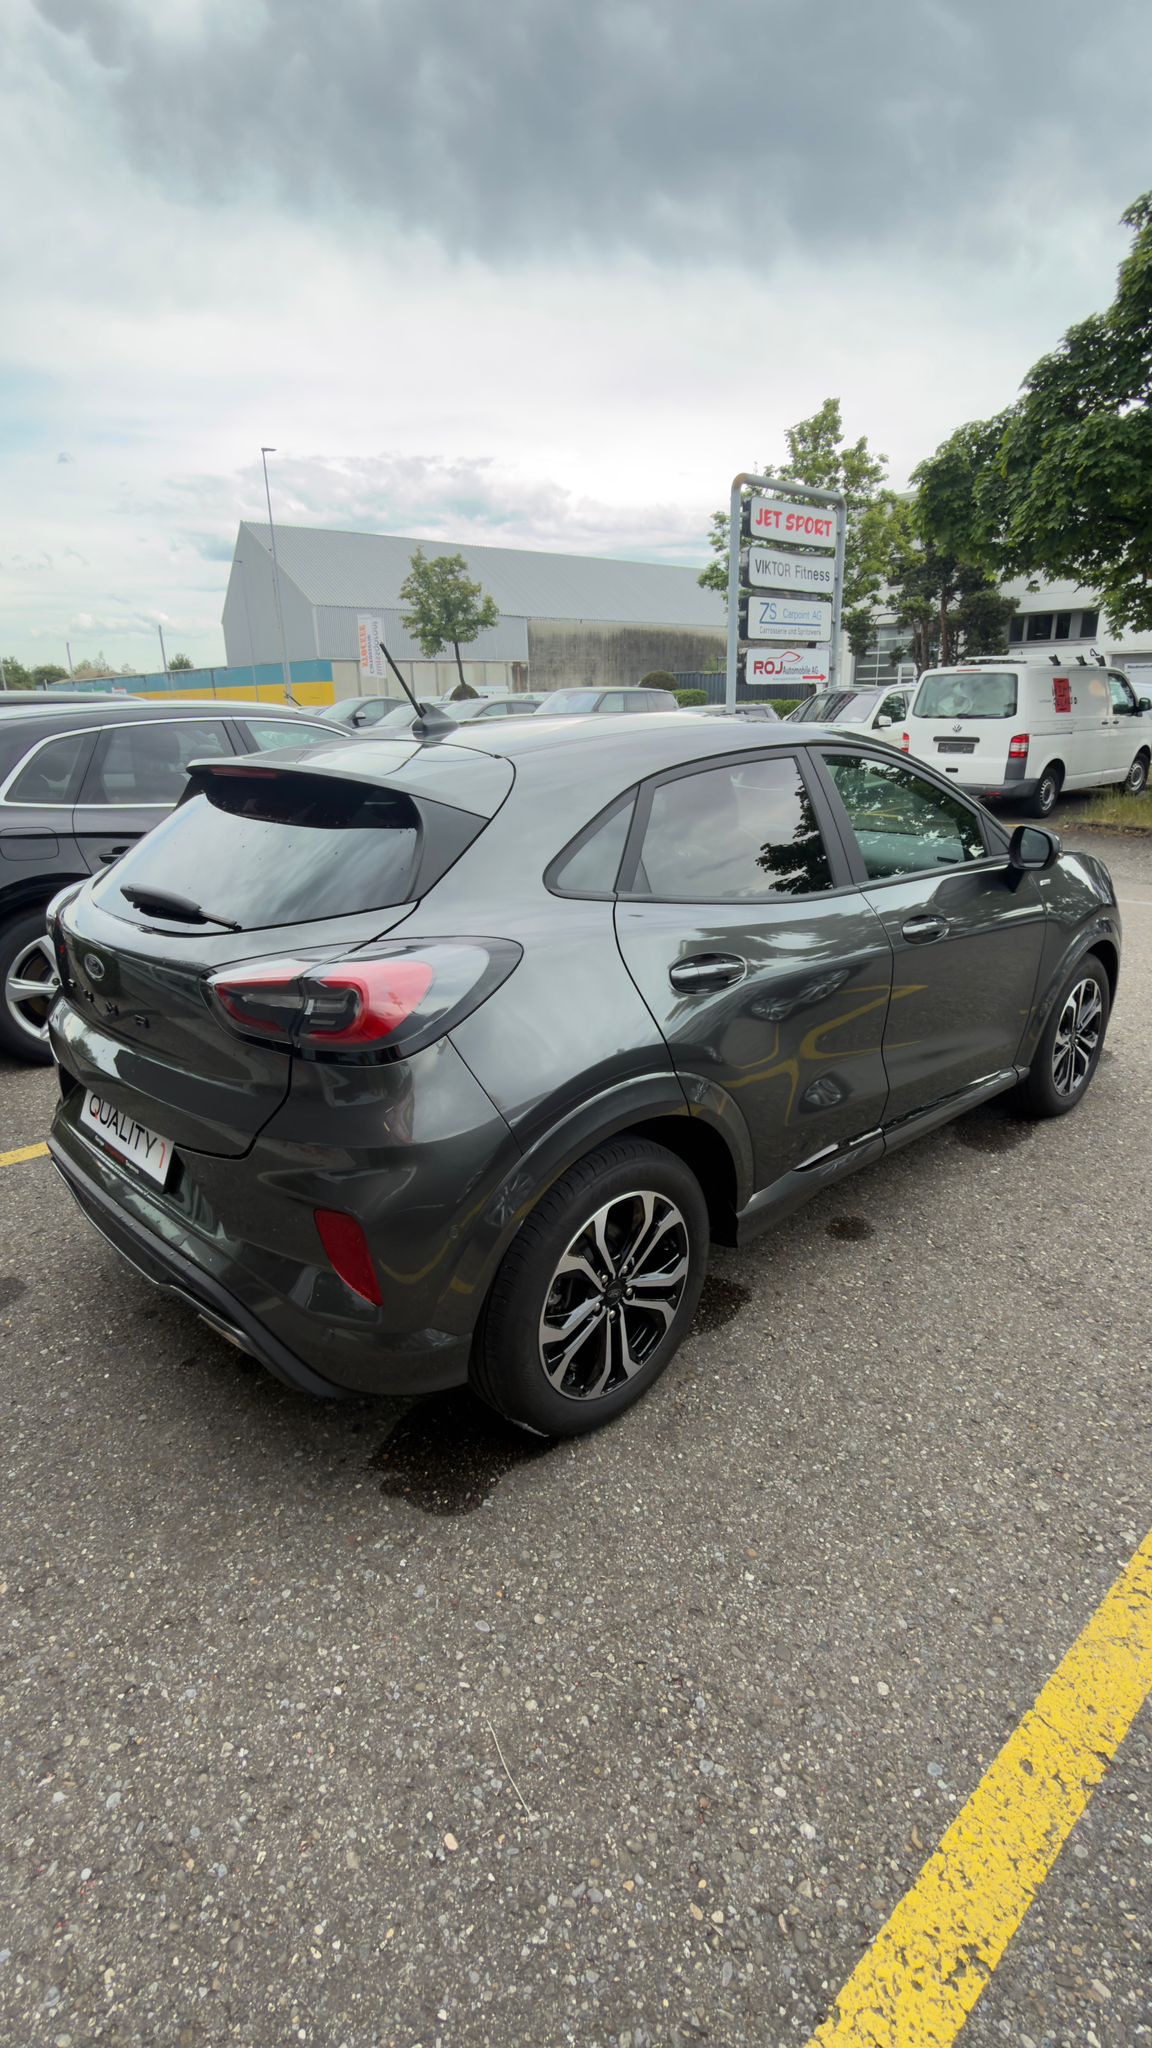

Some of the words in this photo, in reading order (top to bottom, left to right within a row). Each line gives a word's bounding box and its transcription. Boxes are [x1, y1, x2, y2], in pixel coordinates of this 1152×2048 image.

[755, 508, 782, 528] JET
[785, 514, 832, 537] SPORT
[754, 559, 791, 578] VIKTOR
[795, 565, 831, 582] Fitness
[811, 609, 822, 621] AG
[753, 660, 783, 675] ROJ
[811, 665, 819, 675] AG
